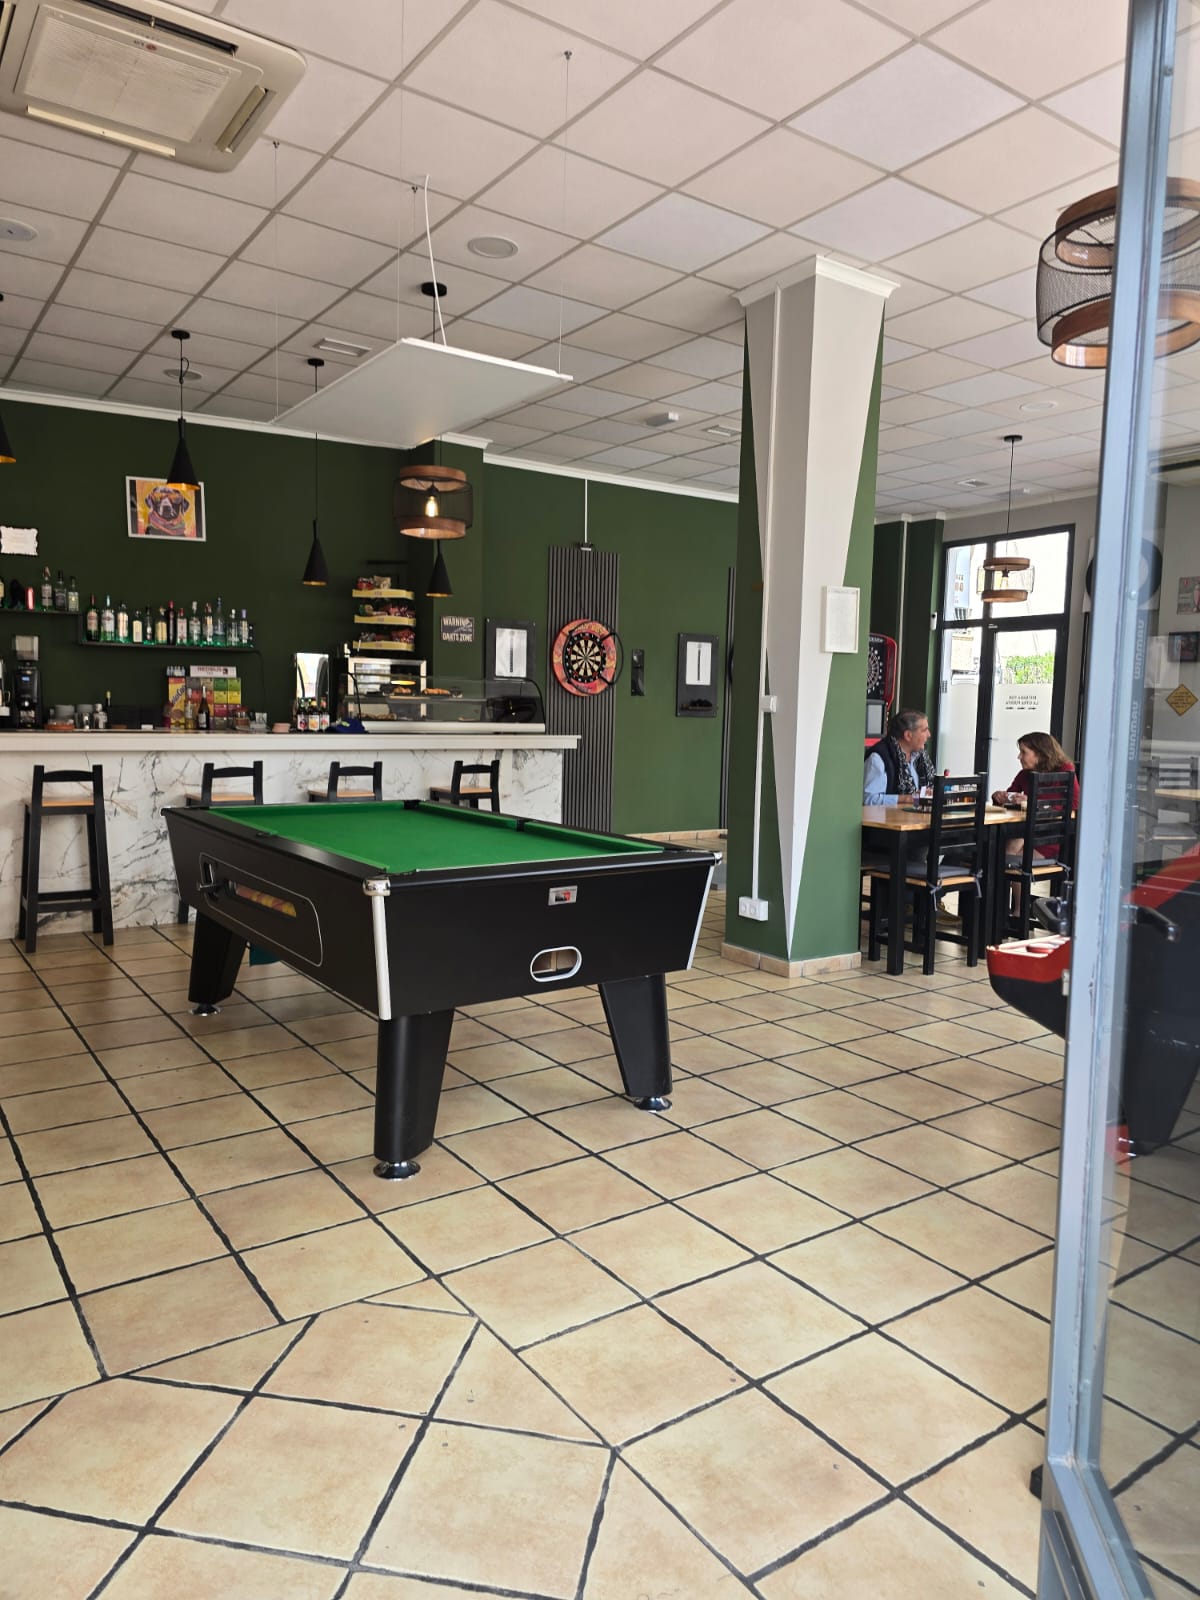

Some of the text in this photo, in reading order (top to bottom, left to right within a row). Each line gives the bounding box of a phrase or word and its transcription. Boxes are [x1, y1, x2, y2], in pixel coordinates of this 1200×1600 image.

[443, 632, 472, 643] DARTS ZONE
[1134, 620, 1145, 680] winmau
[1128, 701, 1139, 761] winmau
